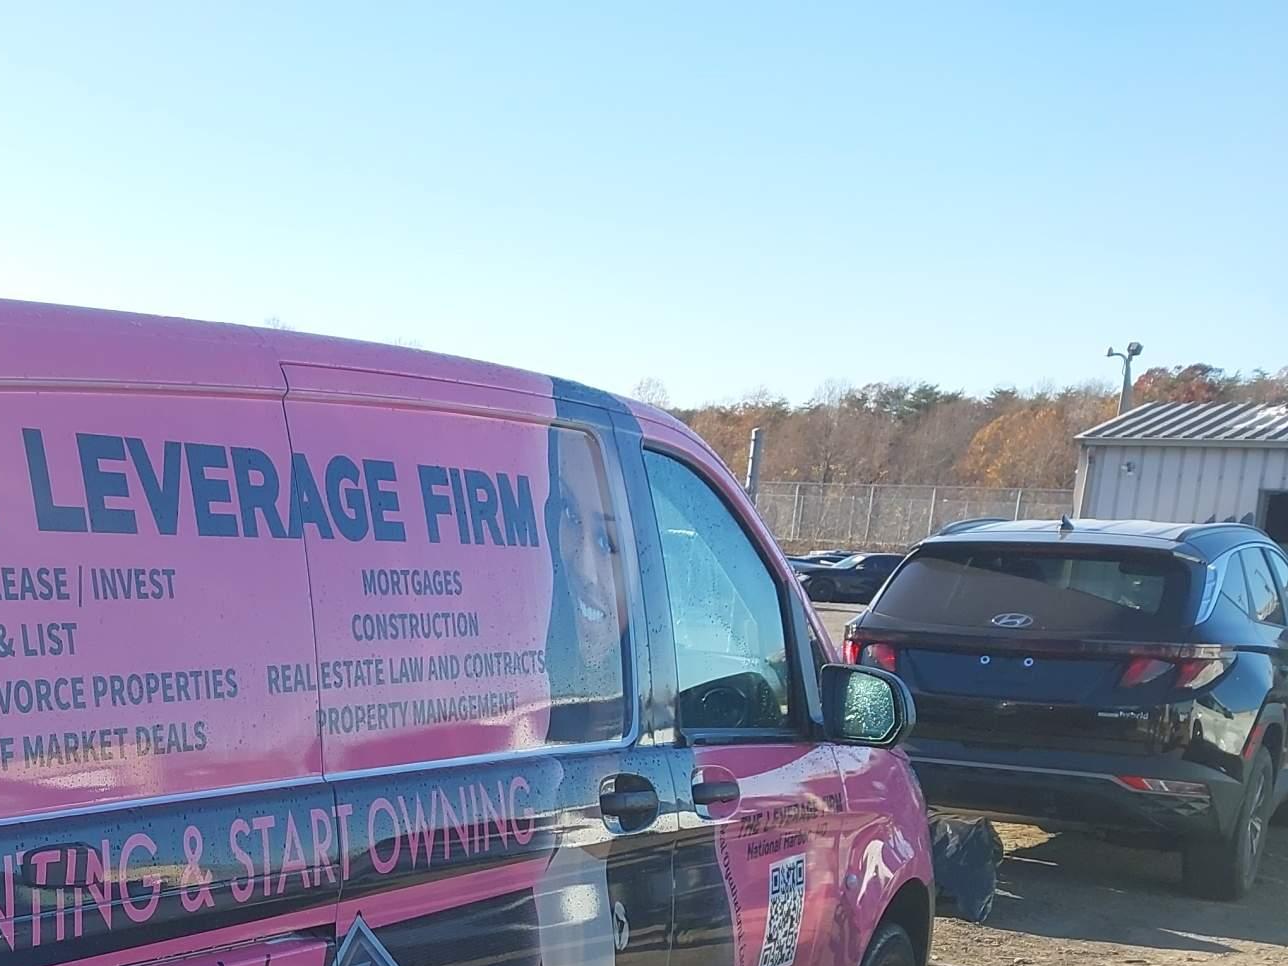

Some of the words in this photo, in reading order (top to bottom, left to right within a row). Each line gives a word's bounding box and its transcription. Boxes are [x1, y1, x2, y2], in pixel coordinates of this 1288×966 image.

[21, 427, 407, 542] LEVERAGE
[417, 463, 540, 548] FIRM
[91, 568, 176, 600] INVEST
[361, 568, 463, 596] MORTGAGES
[21, 622, 78, 657] LIST
[351, 612, 479, 642] CONSTRUCTION
[92, 667, 238, 709] PROPERTIES
[267, 664, 318, 695] REAL
[320, 656, 385, 690] ESTATE
[389, 655, 424, 685] LAW
[428, 654, 460, 681] AND
[463, 649, 545, 679] CONTRACTS
[315, 701, 409, 737] PROPERTY
[412, 690, 518, 727] MANAGEMENT
[1119, 711, 1149, 720] hybrid
[23, 727, 128, 769] MARKET
[135, 720, 208, 759] DEALS
[179, 826, 216, 912] &
[229, 804, 353, 903] START
[367, 776, 536, 874] OWNING
[747, 838, 782, 861] National
